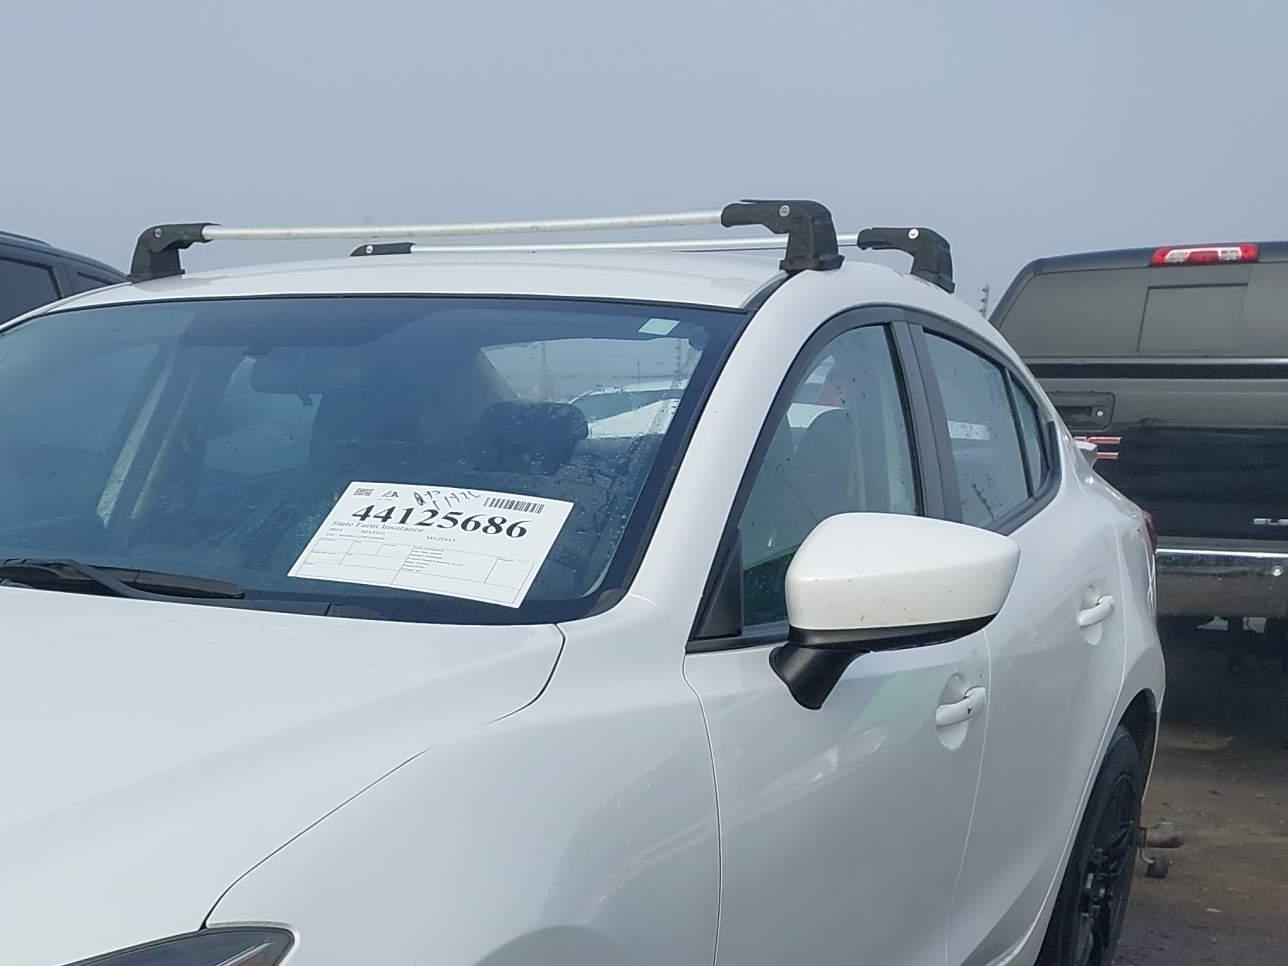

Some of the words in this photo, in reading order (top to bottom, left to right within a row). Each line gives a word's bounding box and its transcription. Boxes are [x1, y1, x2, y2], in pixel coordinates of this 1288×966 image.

[352, 504, 531, 538] 44125686
[356, 521, 378, 529] Farm
[381, 523, 424, 533] Insurance
